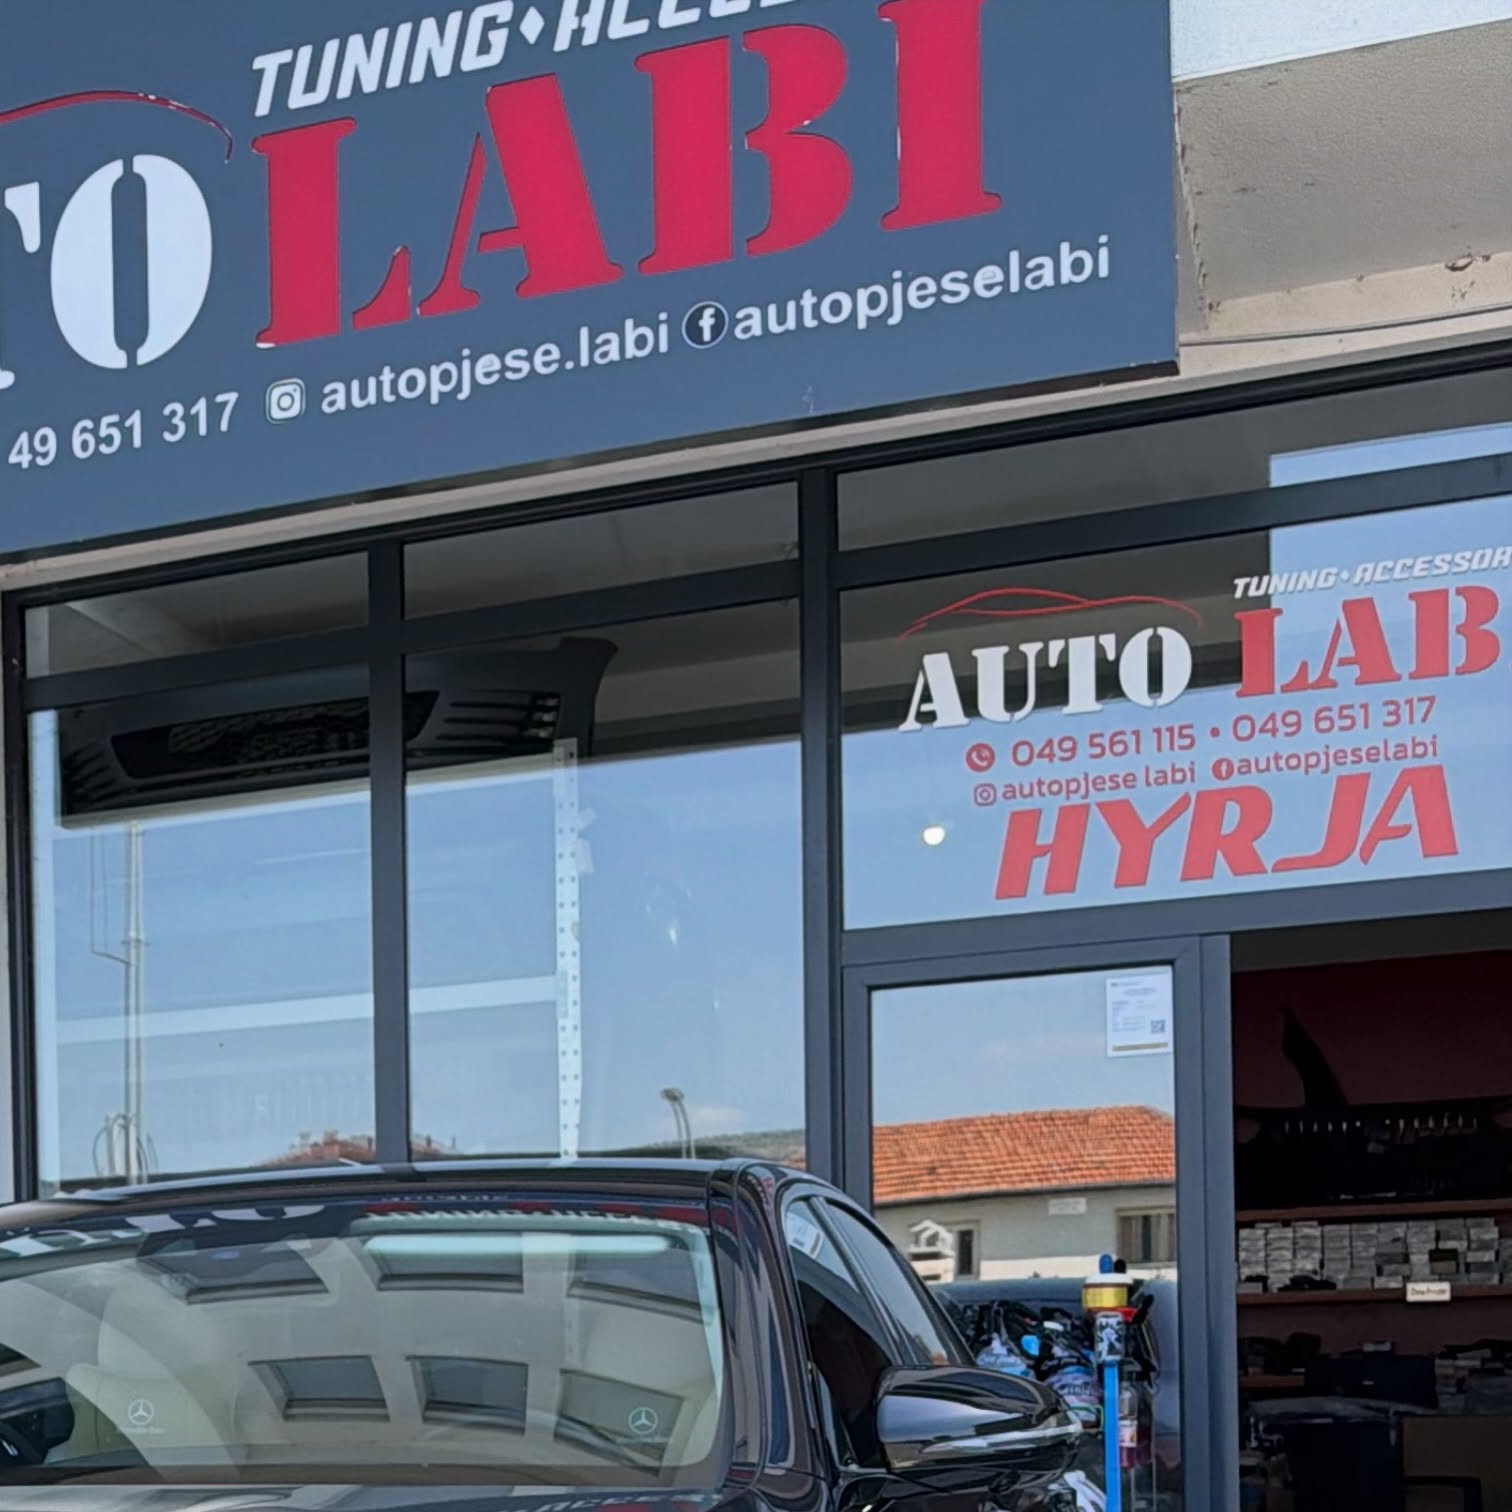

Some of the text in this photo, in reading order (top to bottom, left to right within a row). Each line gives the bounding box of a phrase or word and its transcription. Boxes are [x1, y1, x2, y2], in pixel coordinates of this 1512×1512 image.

[252, 0, 513, 117] TUNING
[250, 0, 1002, 348] LABI
[733, 236, 1110, 340] autopjeselabi
[320, 314, 669, 415] autopjese.labi
[8, 425, 58, 471] 49
[71, 407, 144, 458] 651
[161, 392, 239, 444] 317
[1233, 567, 1338, 599] TUNING
[899, 586, 1512, 732] AUTO LAB
[1012, 696, 1436, 766] 049 561 115 049 651 317
[1237, 735, 1438, 776] autopjeselabi
[994, 765, 1458, 900] HYRJA
